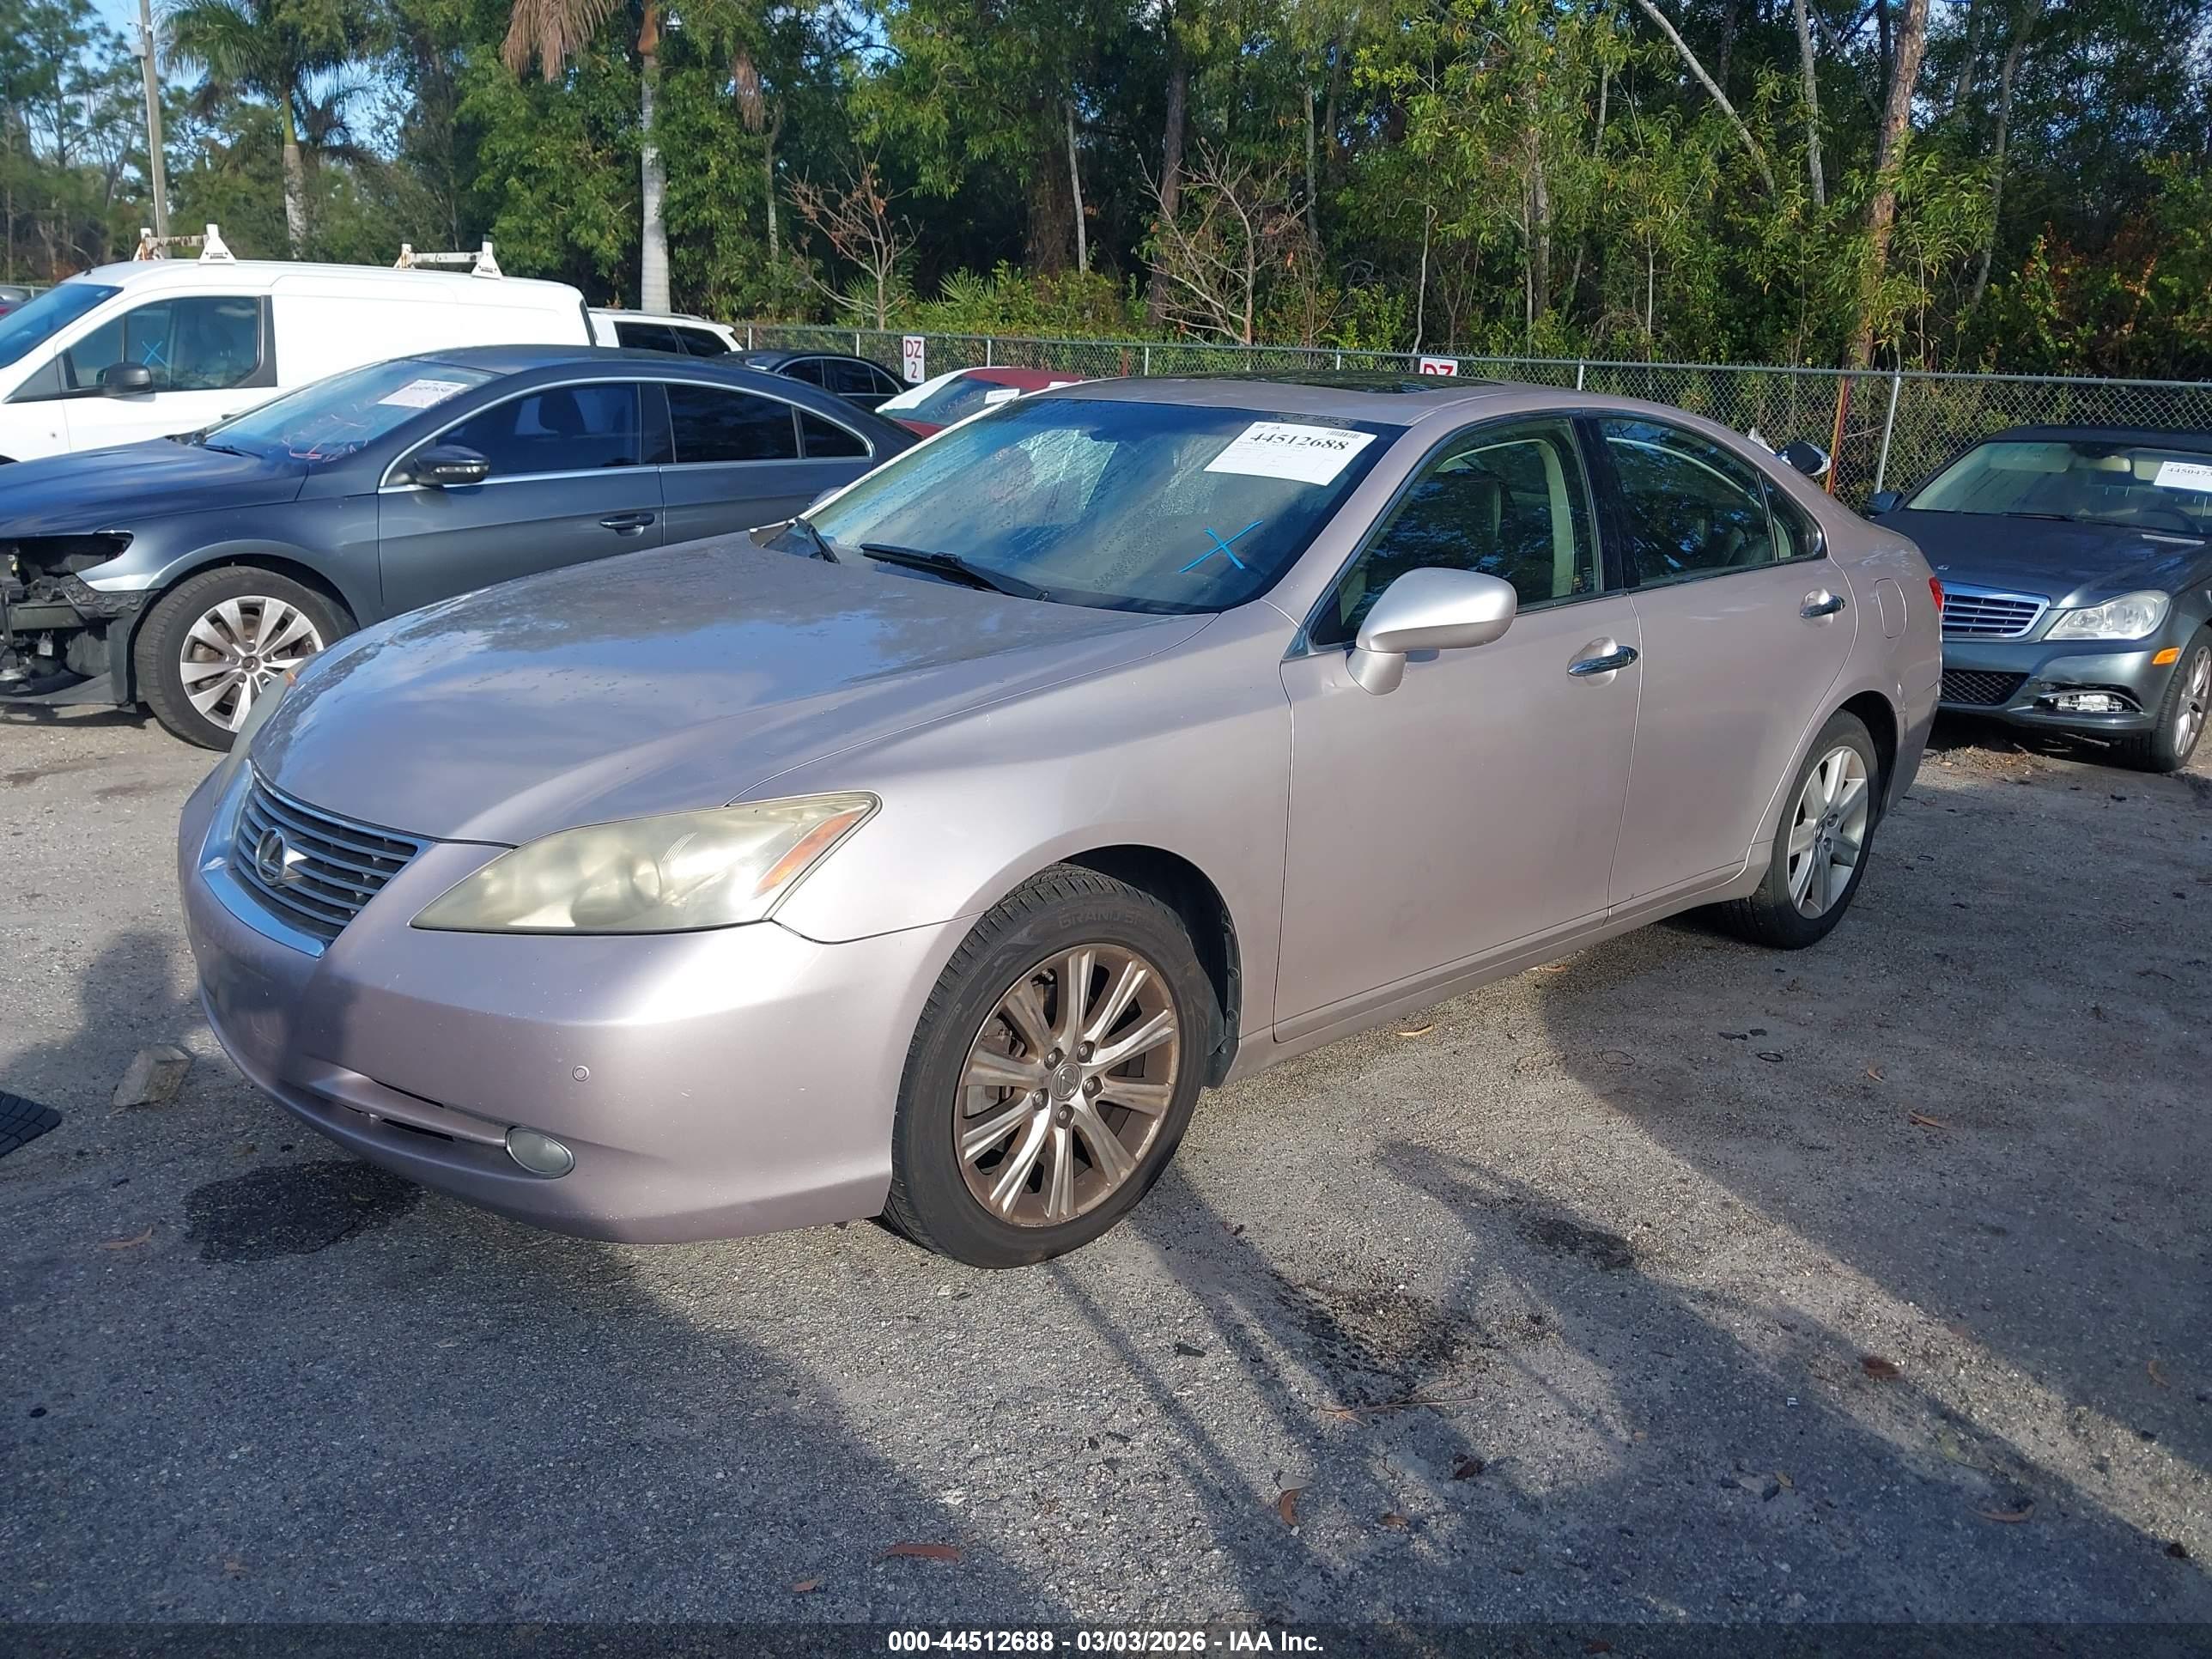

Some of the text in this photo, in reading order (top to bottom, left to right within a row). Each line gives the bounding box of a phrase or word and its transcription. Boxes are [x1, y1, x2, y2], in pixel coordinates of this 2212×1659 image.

[906, 340, 921, 358] DZ
[911, 362, 917, 379] 2
[1250, 433, 1350, 450] 44512688
